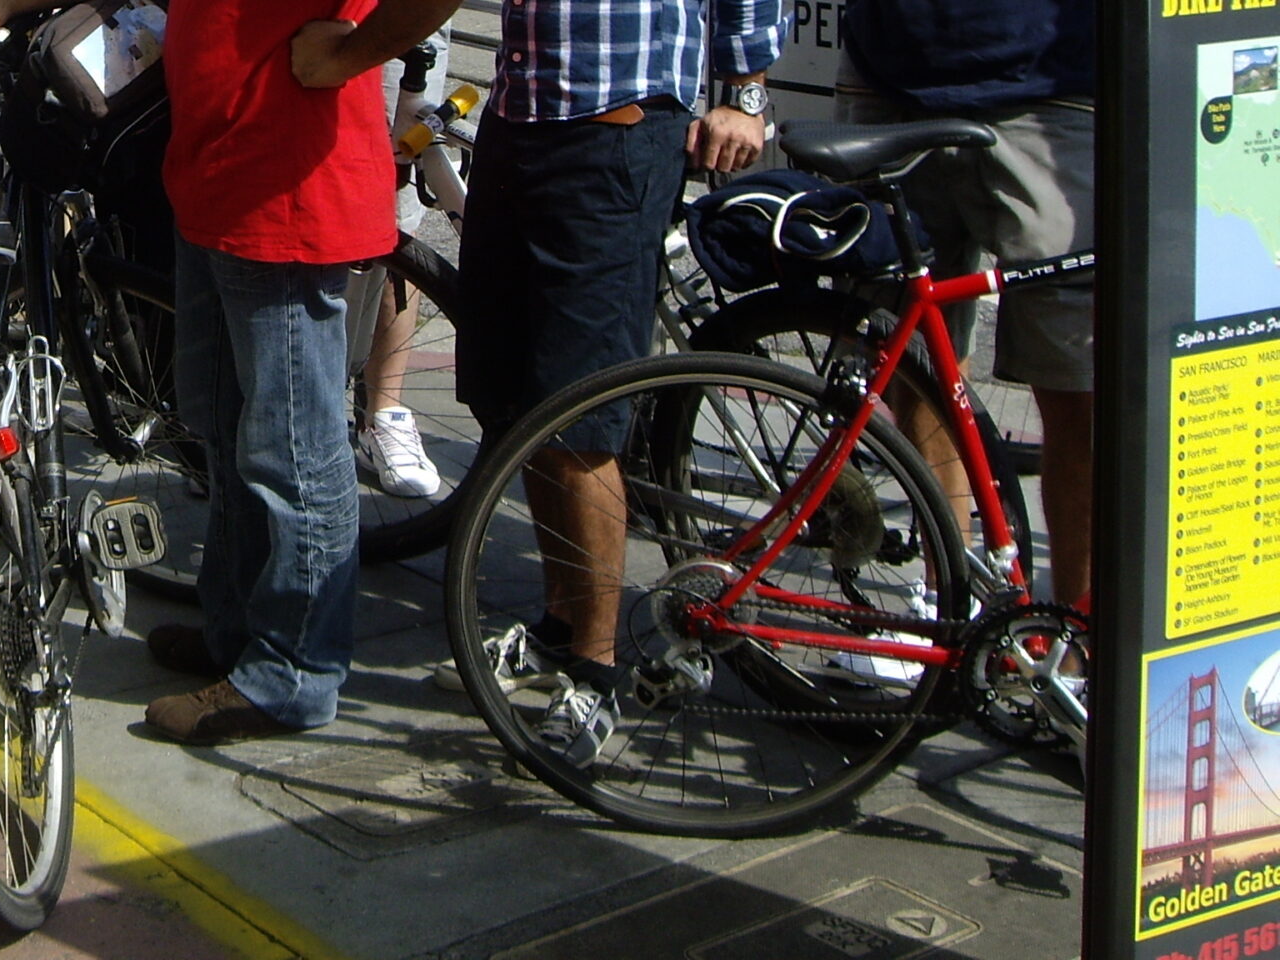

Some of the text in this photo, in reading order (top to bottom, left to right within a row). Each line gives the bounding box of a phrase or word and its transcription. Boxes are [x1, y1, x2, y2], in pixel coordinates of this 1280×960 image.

[1176, 330, 1205, 349] Sights
[1207, 330, 1216, 341] to
[1218, 326, 1235, 340] See
[1236, 326, 1246, 336] in
[1247, 321, 1265, 335] San
[1179, 355, 1248, 379] SAN FRANCISCO
[1187, 459, 1246, 477] Golden Gate Bridge
[1216, 479, 1226, 489] the
[1185, 524, 1212, 537] Windmill
[1148, 865, 1280, 922] Golden Gate
[1243, 922, 1280, 956] 56
